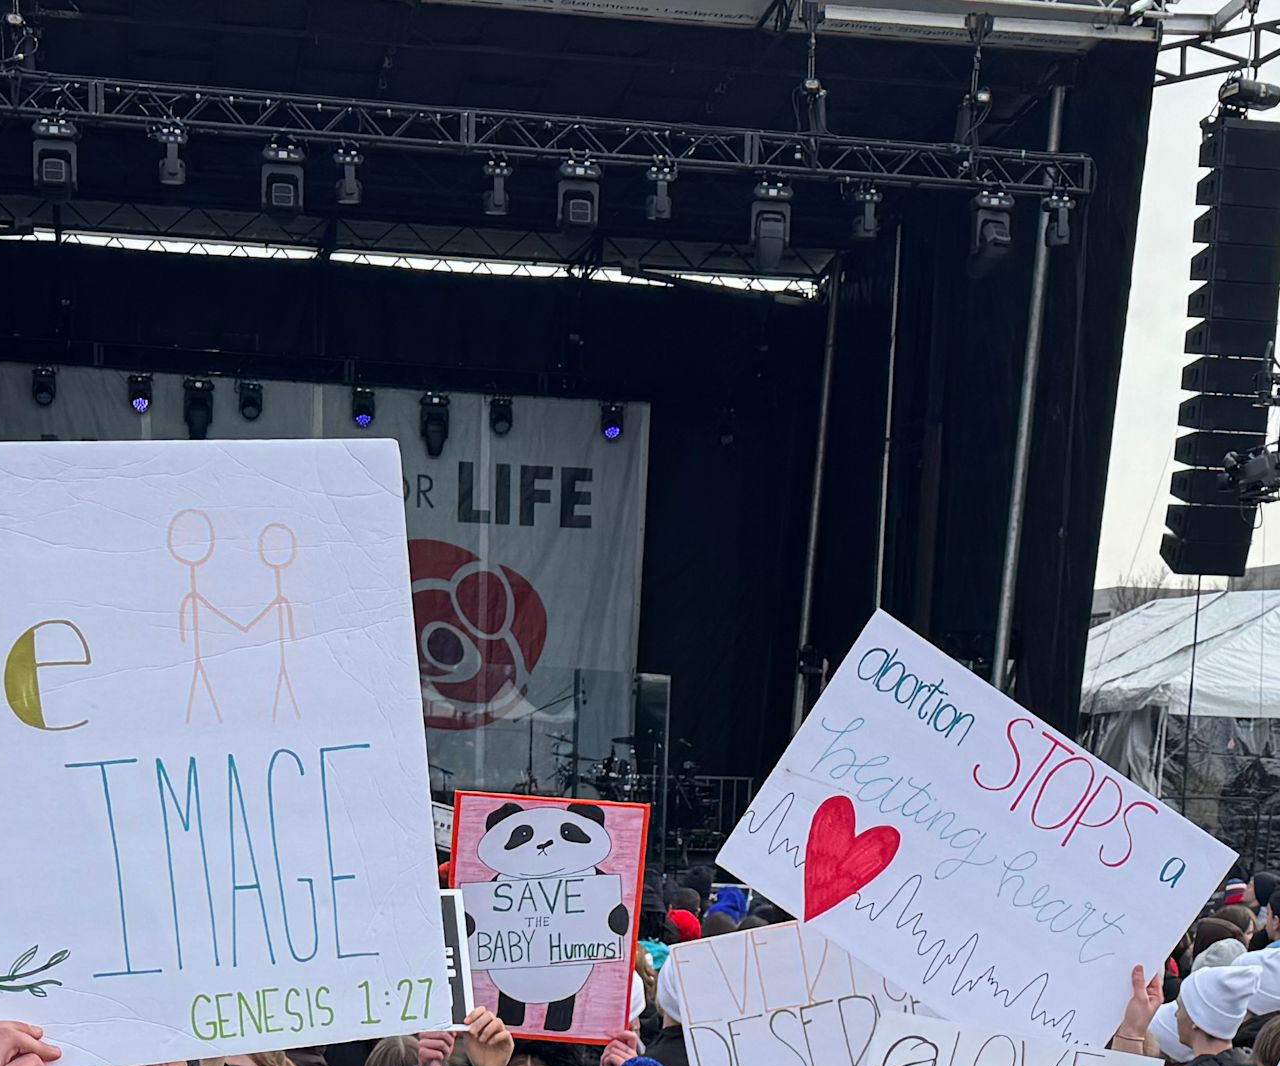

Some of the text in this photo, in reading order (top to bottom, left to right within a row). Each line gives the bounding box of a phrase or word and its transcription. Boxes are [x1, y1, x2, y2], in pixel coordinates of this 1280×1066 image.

[457, 460, 594, 529] LIFE
[857, 647, 1186, 889] abortion STOPS a
[64, 743, 379, 978] IMAGE
[492, 878, 586, 915] SAVE
[524, 915, 551, 928] THE
[996, 850, 1126, 964] heart
[476, 929, 536, 963] BABY
[189, 978, 436, 1043] GENESIS 1:27
